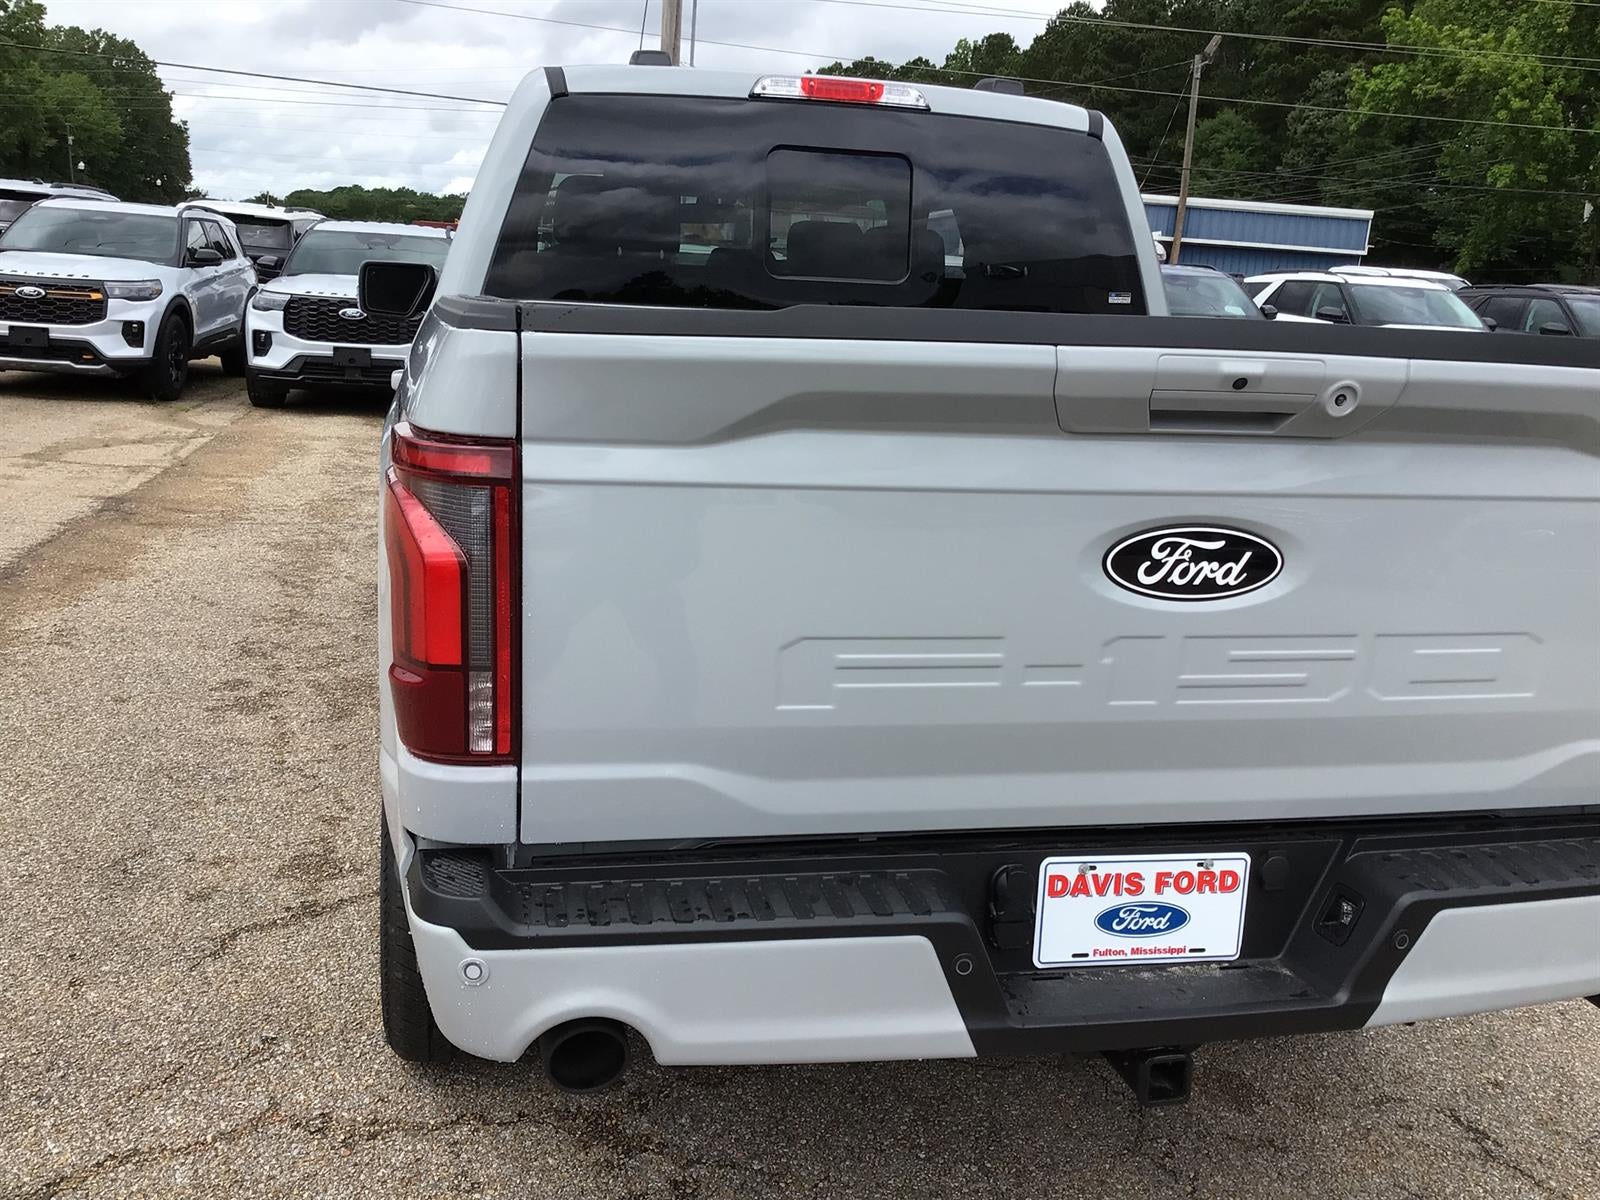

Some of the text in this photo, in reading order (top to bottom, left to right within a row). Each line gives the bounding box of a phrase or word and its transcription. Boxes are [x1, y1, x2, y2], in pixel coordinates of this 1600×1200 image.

[1137, 537, 1253, 586] Ford
[775, 632, 1543, 710] F-150
[1047, 869, 1241, 898] DAVIS FORD
[1112, 906, 1173, 931] Ford
[1092, 945, 1187, 958] Fulton, Mississippi
